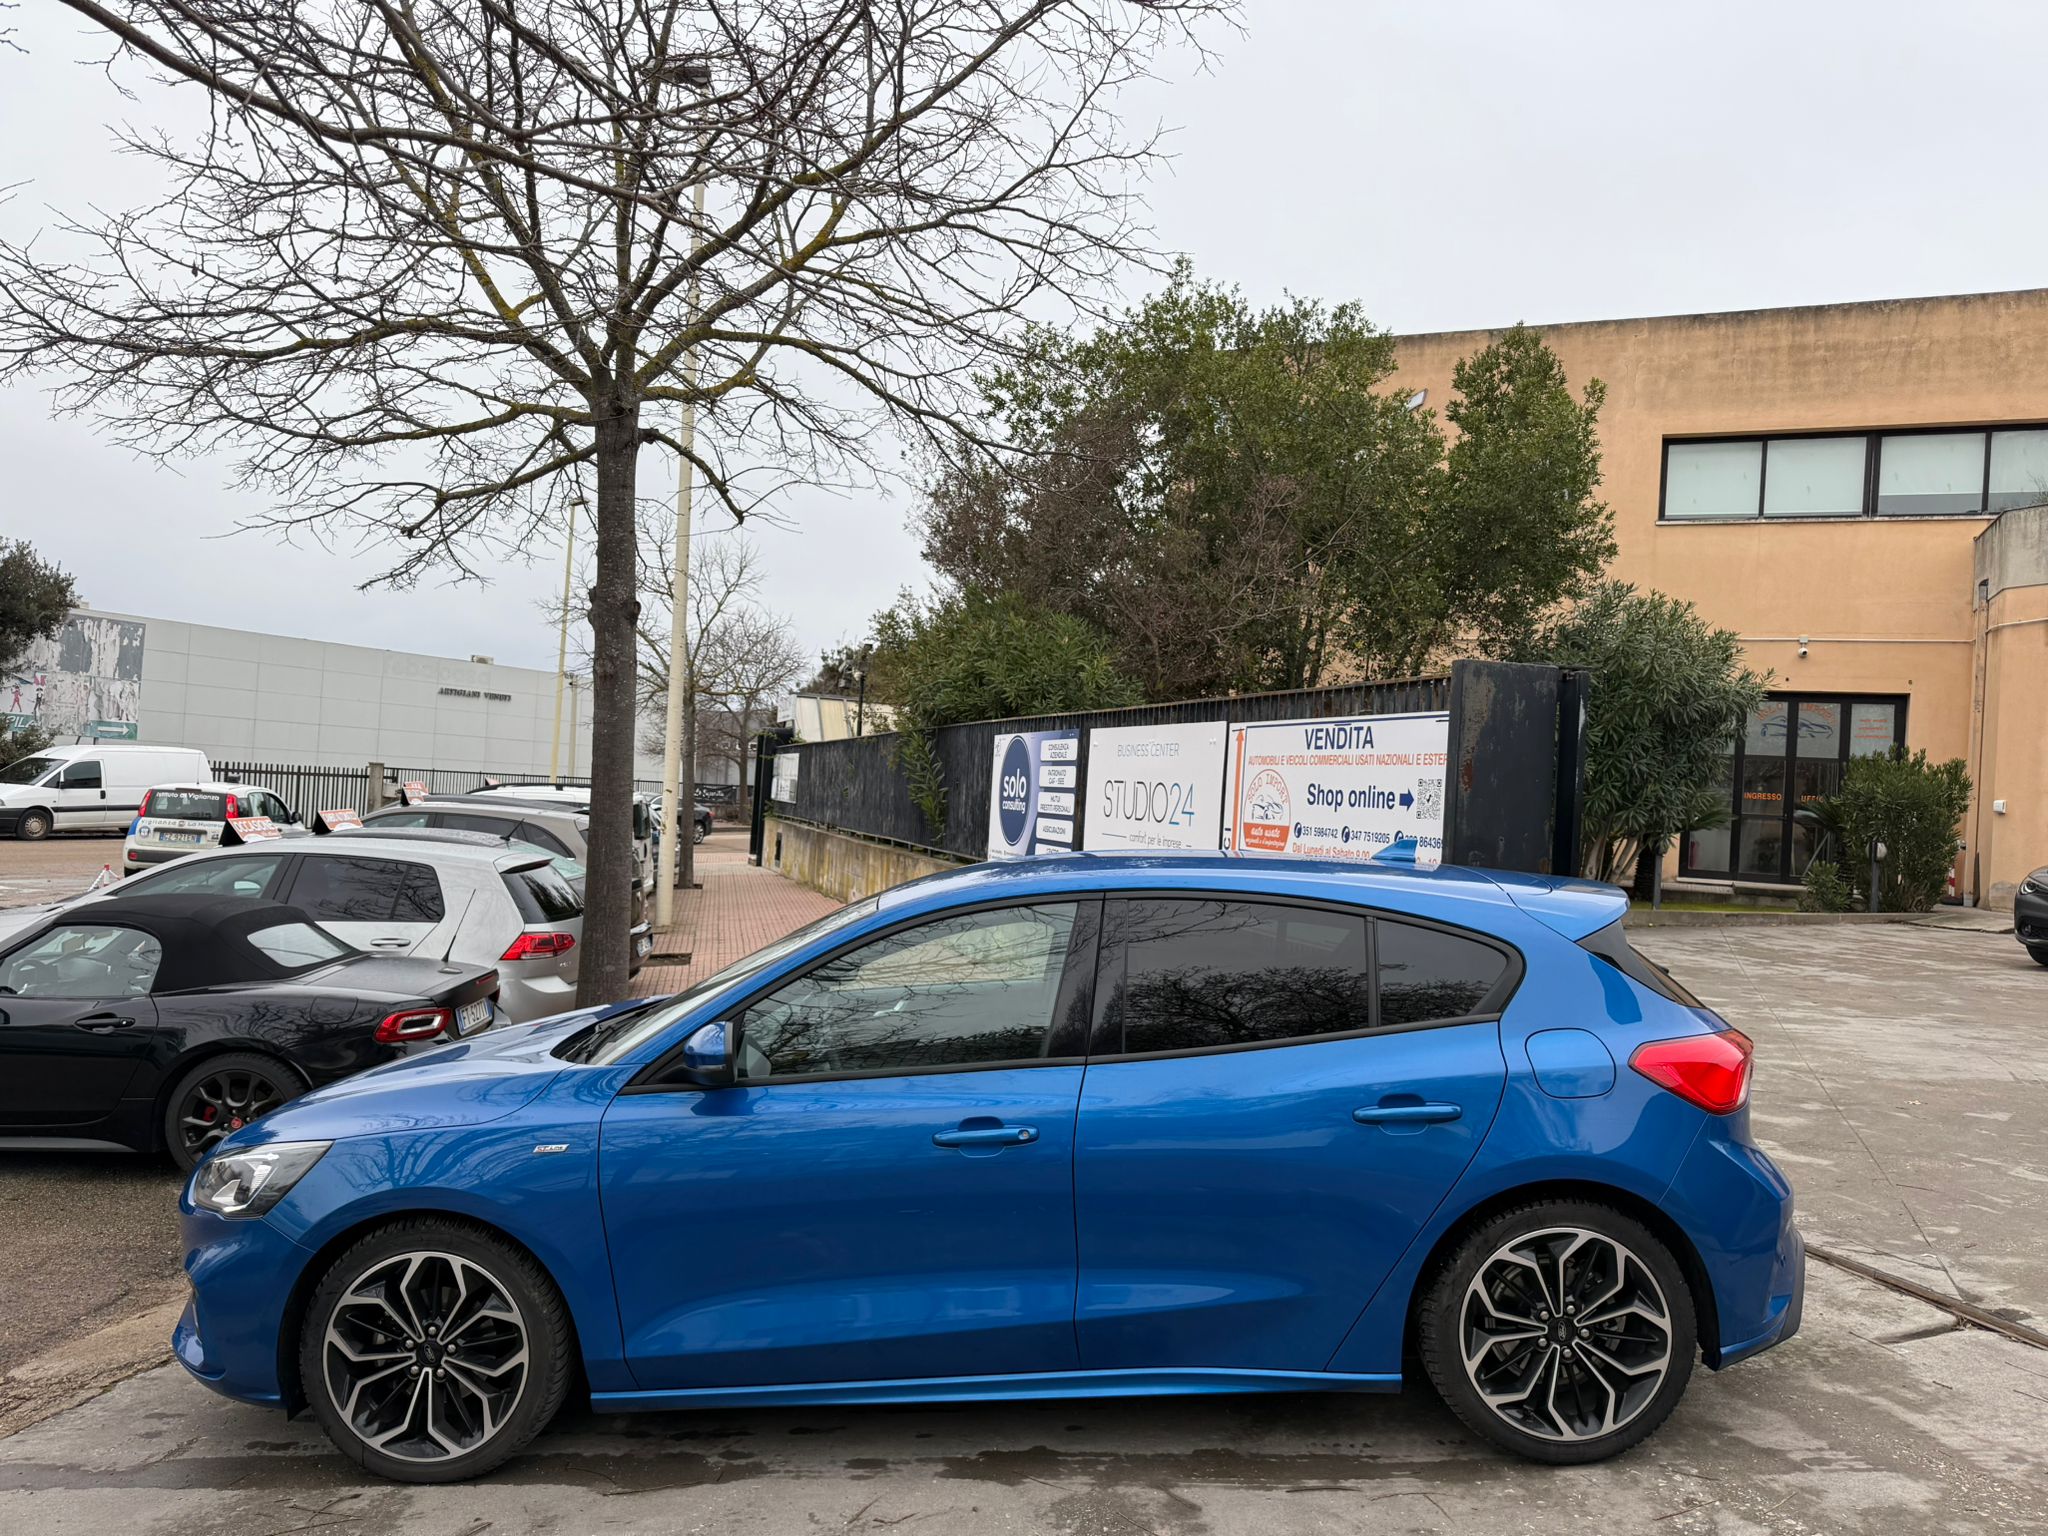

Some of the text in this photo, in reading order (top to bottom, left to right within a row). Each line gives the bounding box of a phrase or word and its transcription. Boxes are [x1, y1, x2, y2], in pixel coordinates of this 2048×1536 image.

[1305, 726, 1374, 750] VENDITA
[1117, 743, 1180, 757] BUSINESS CENTER
[1309, 754, 1354, 766] COMMERCIALI
[1355, 754, 1375, 766] USATI
[1376, 753, 1415, 766] NAZIONALI
[1416, 753, 1422, 766] E
[1003, 768, 1027, 799] solo
[188, 793, 220, 801] Vigilanza
[1307, 783, 1396, 812] Shop online
[1744, 792, 1782, 801] INGRESSO
[1002, 798, 1026, 815] consulting
[1302, 826, 1312, 836] 351
[1351, 830, 1390, 844] 347 7519205
[1419, 836, 1443, 849] 86436
